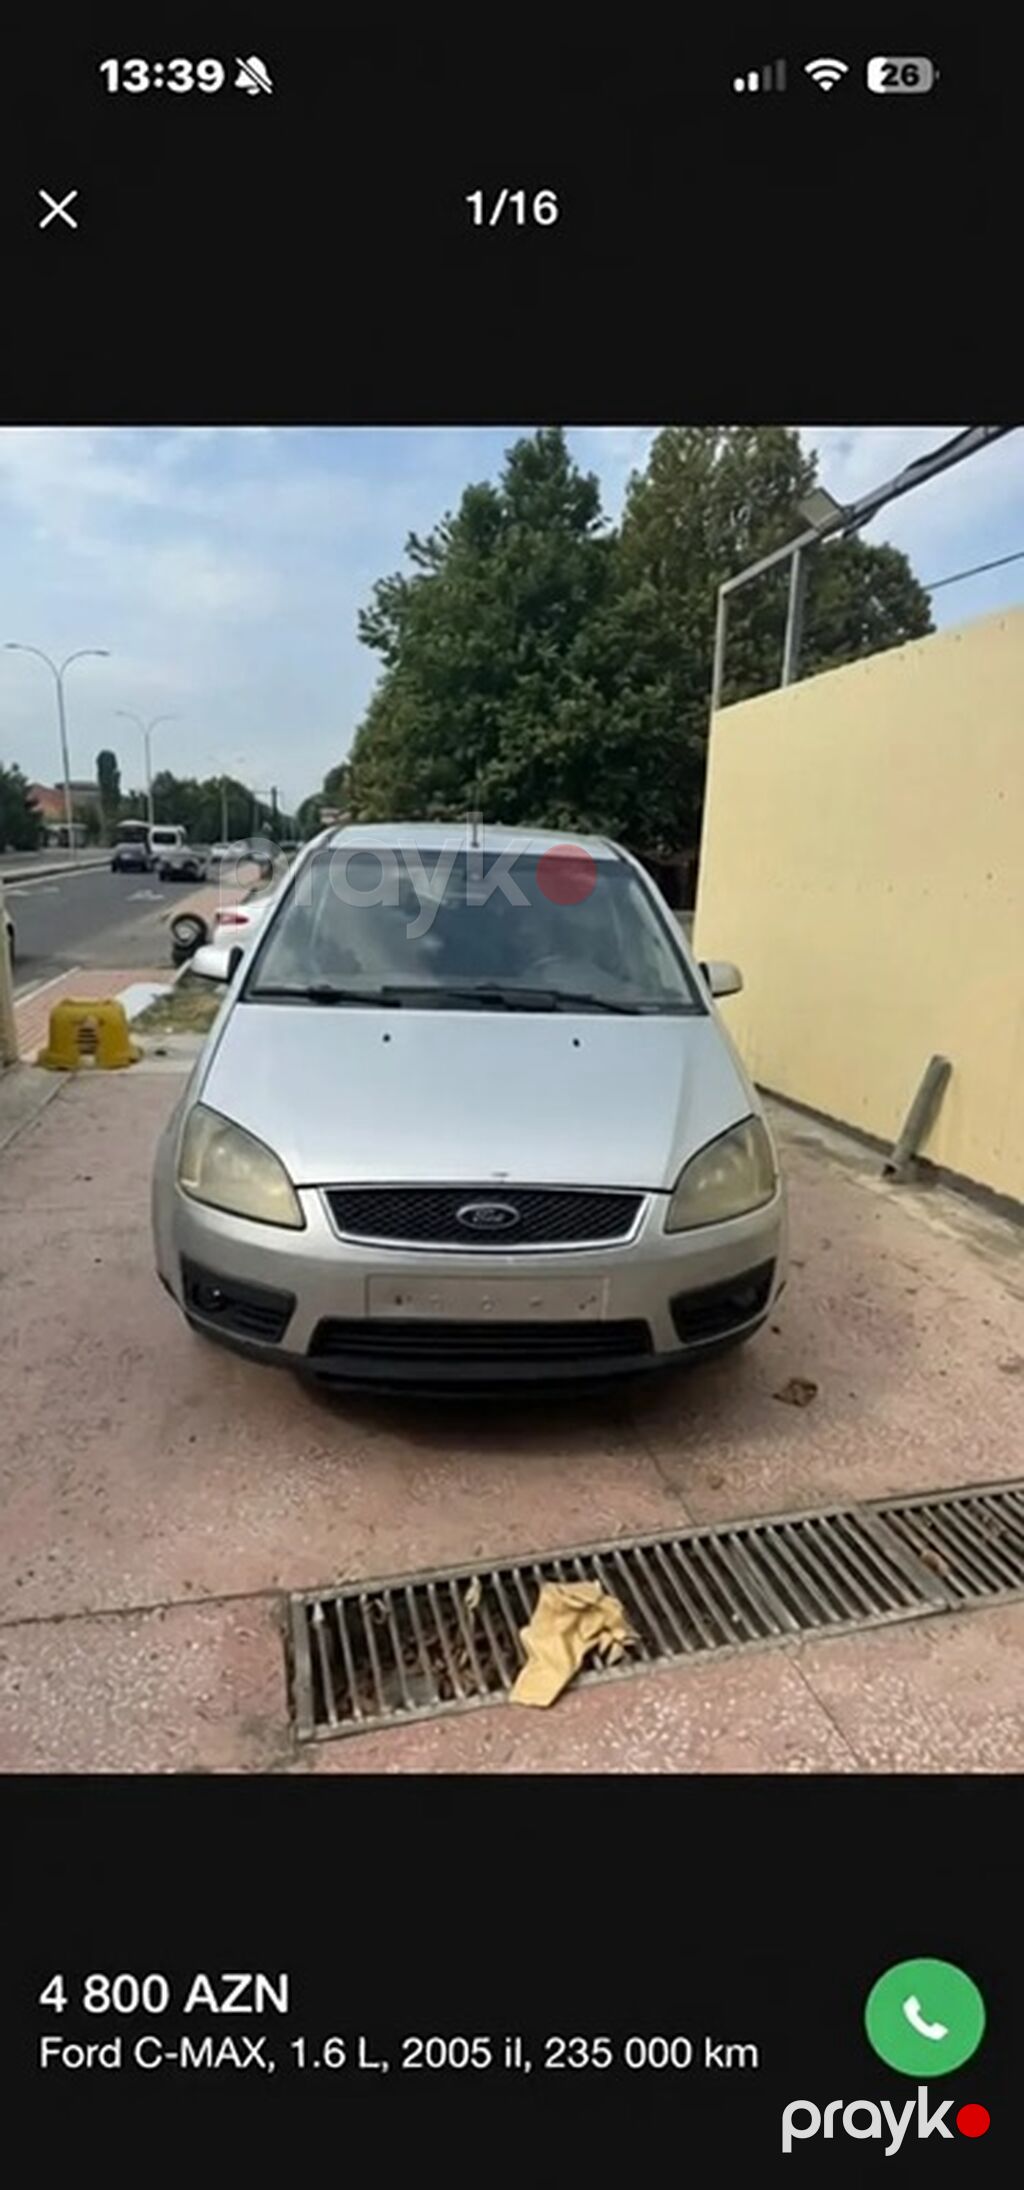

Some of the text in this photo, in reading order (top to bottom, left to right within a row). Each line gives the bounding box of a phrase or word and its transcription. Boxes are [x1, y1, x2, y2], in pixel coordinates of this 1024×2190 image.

[99, 58, 225, 94] 13:39
[880, 63, 921, 87] 26
[465, 188, 559, 226] 1/16
[39, 1973, 289, 2014] 4 800 AZN
[40, 2035, 759, 2073] Ford C-MAX, 1.6 L, 2005 il, 235 000 km
